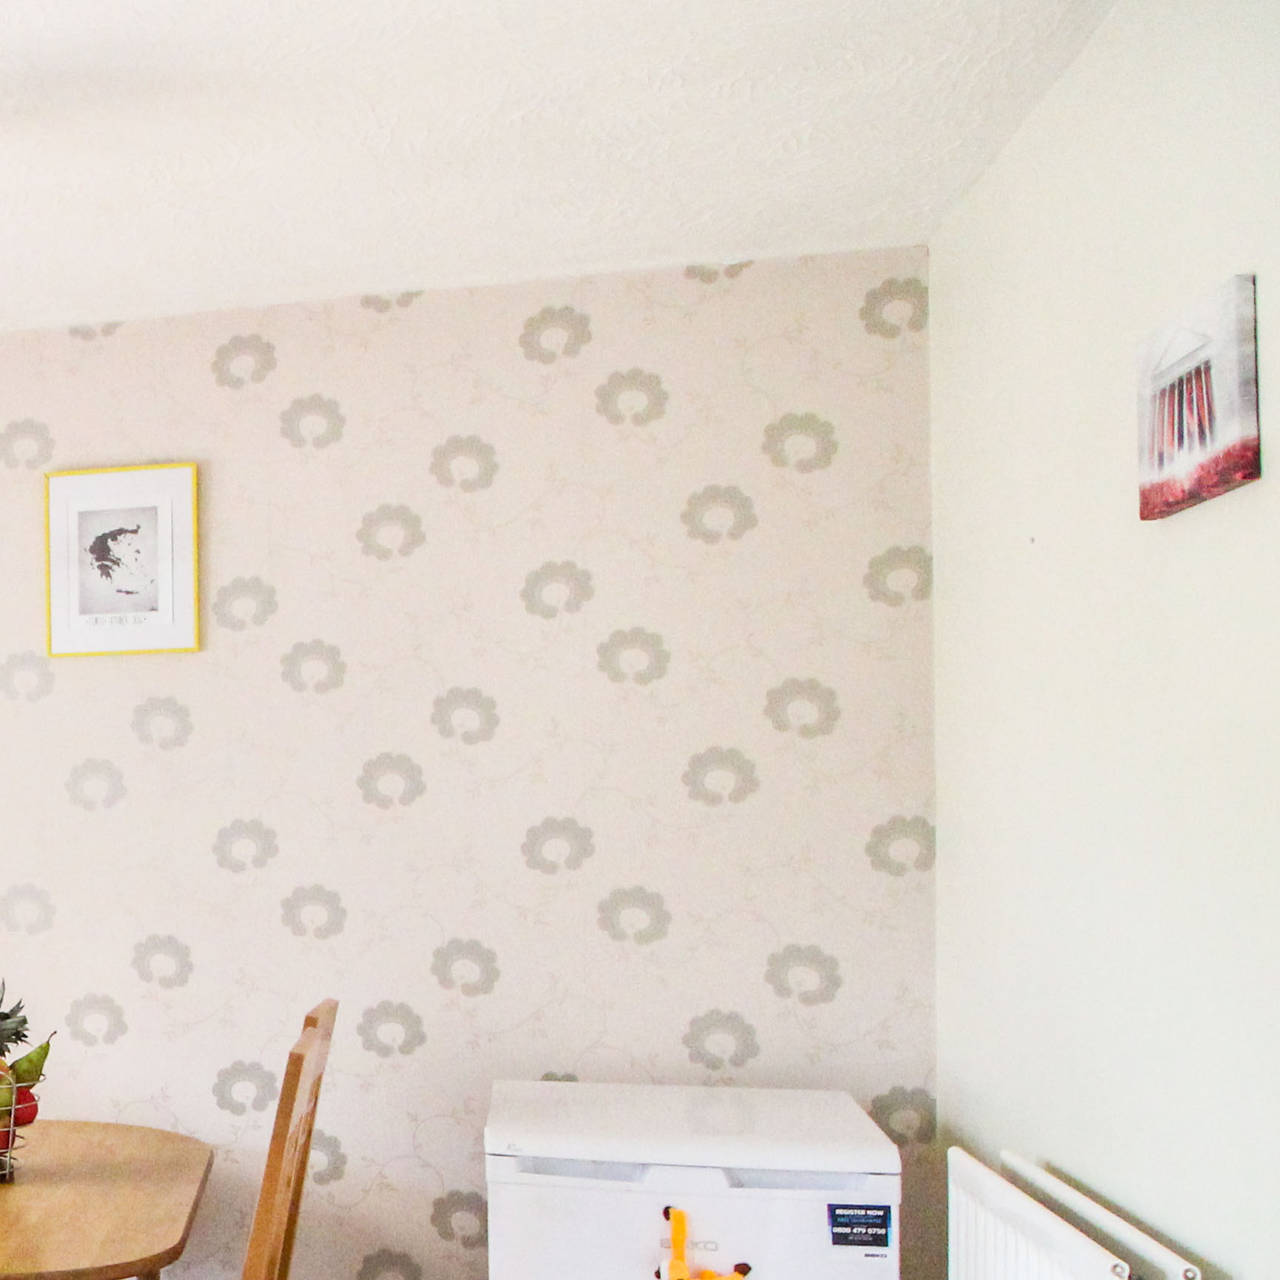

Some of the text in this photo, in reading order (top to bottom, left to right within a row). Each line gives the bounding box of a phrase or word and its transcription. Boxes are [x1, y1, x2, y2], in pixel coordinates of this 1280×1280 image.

[835, 1208, 866, 1216] REGISTER
[832, 1226, 852, 1234] 0800
[852, 1227, 866, 1235] 479
[659, 1238, 719, 1251] BKO
